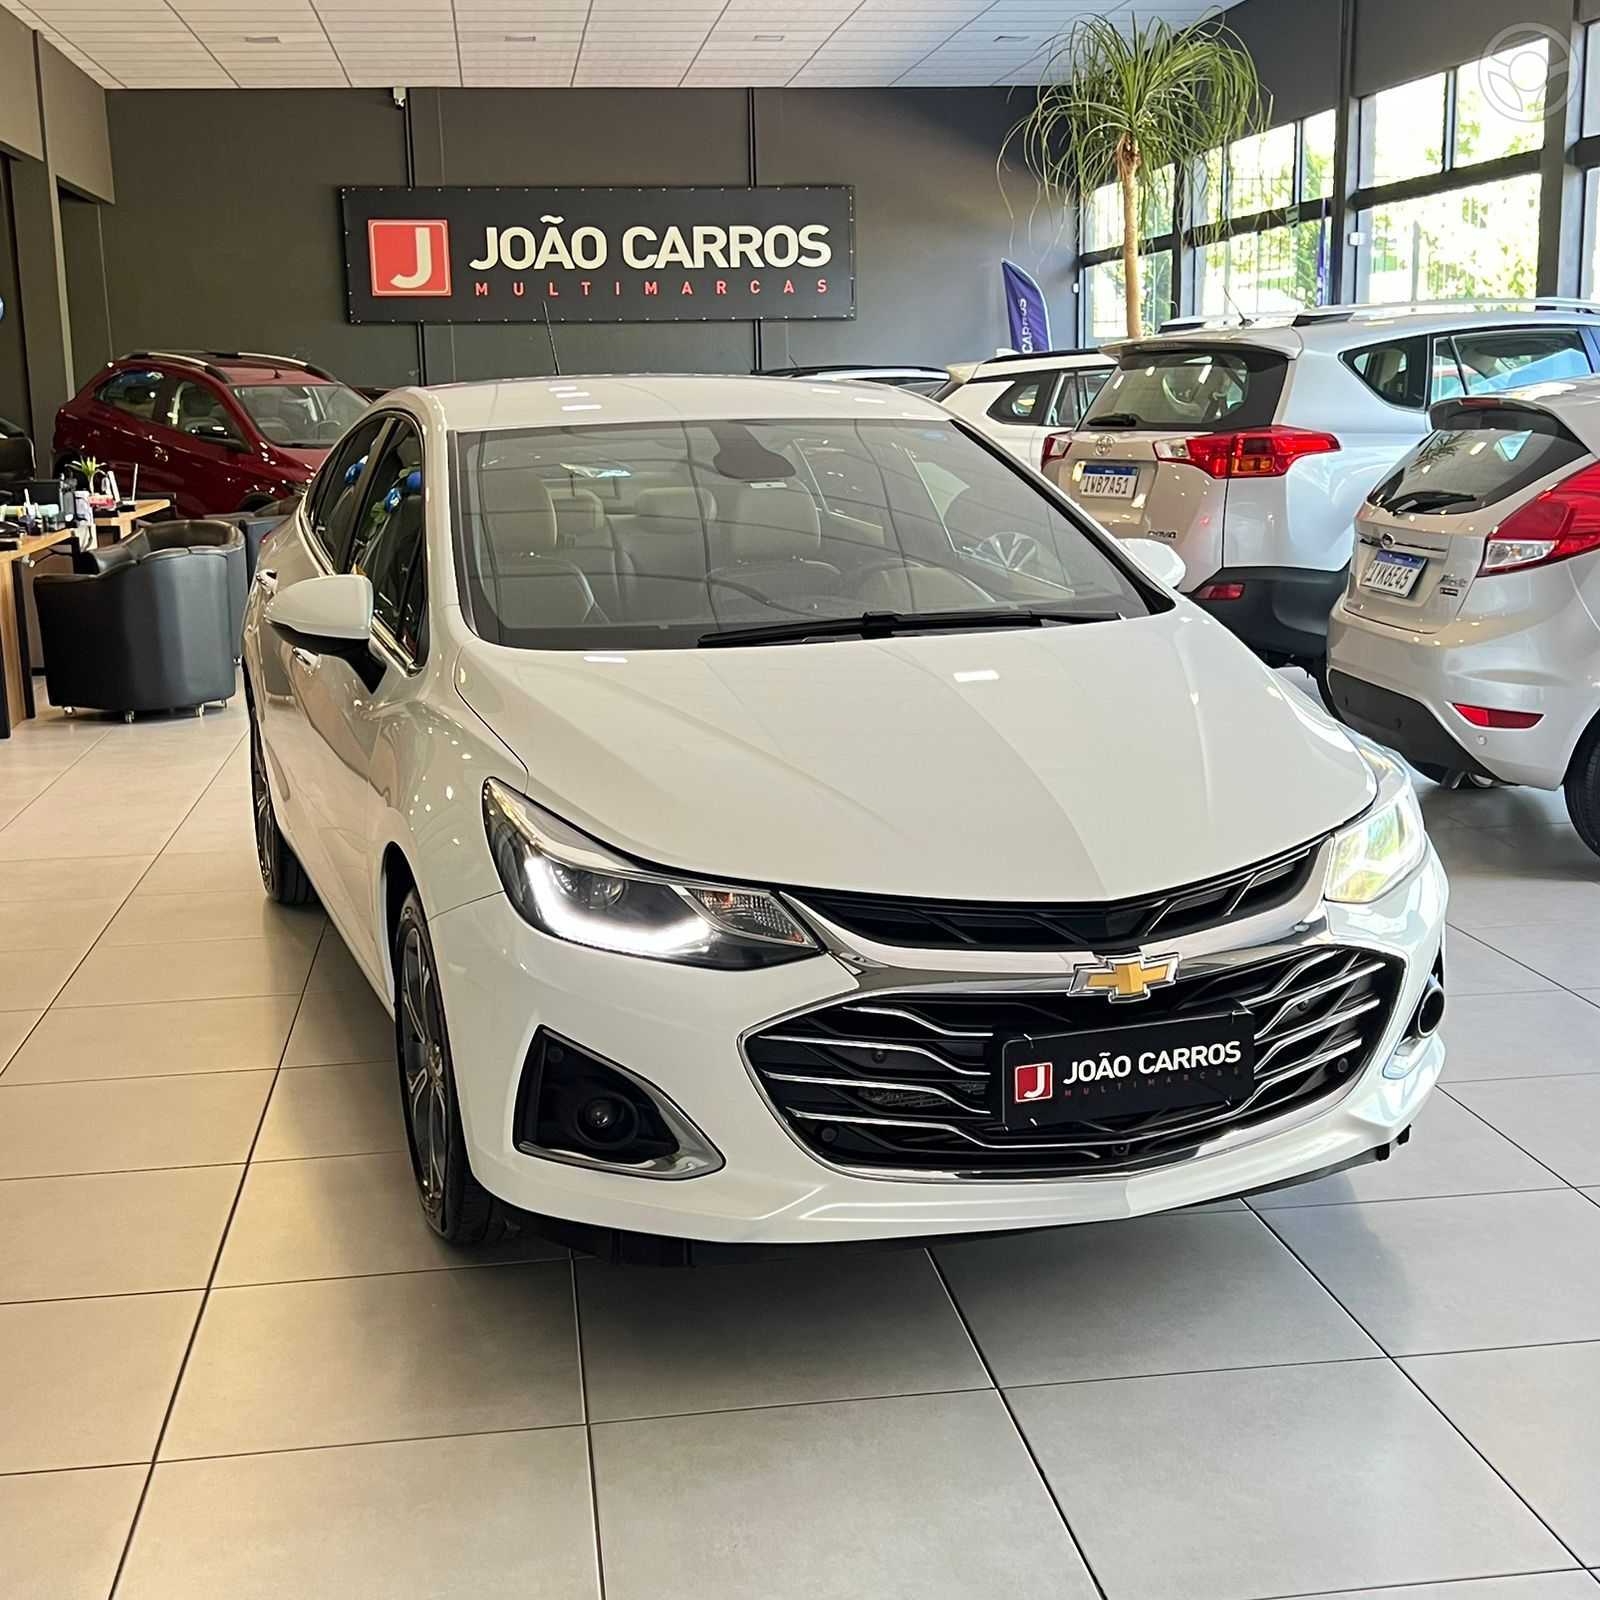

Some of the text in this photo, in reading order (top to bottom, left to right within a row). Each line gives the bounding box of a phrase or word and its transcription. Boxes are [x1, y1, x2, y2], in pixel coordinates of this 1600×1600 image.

[390, 226, 432, 289] J
[469, 215, 833, 270] JOÃO CARROS
[474, 279, 830, 297] MULTIMARCAS
[1023, 1065, 1046, 1099] J
[1063, 1041, 1242, 1085] JOÃO CARROS
